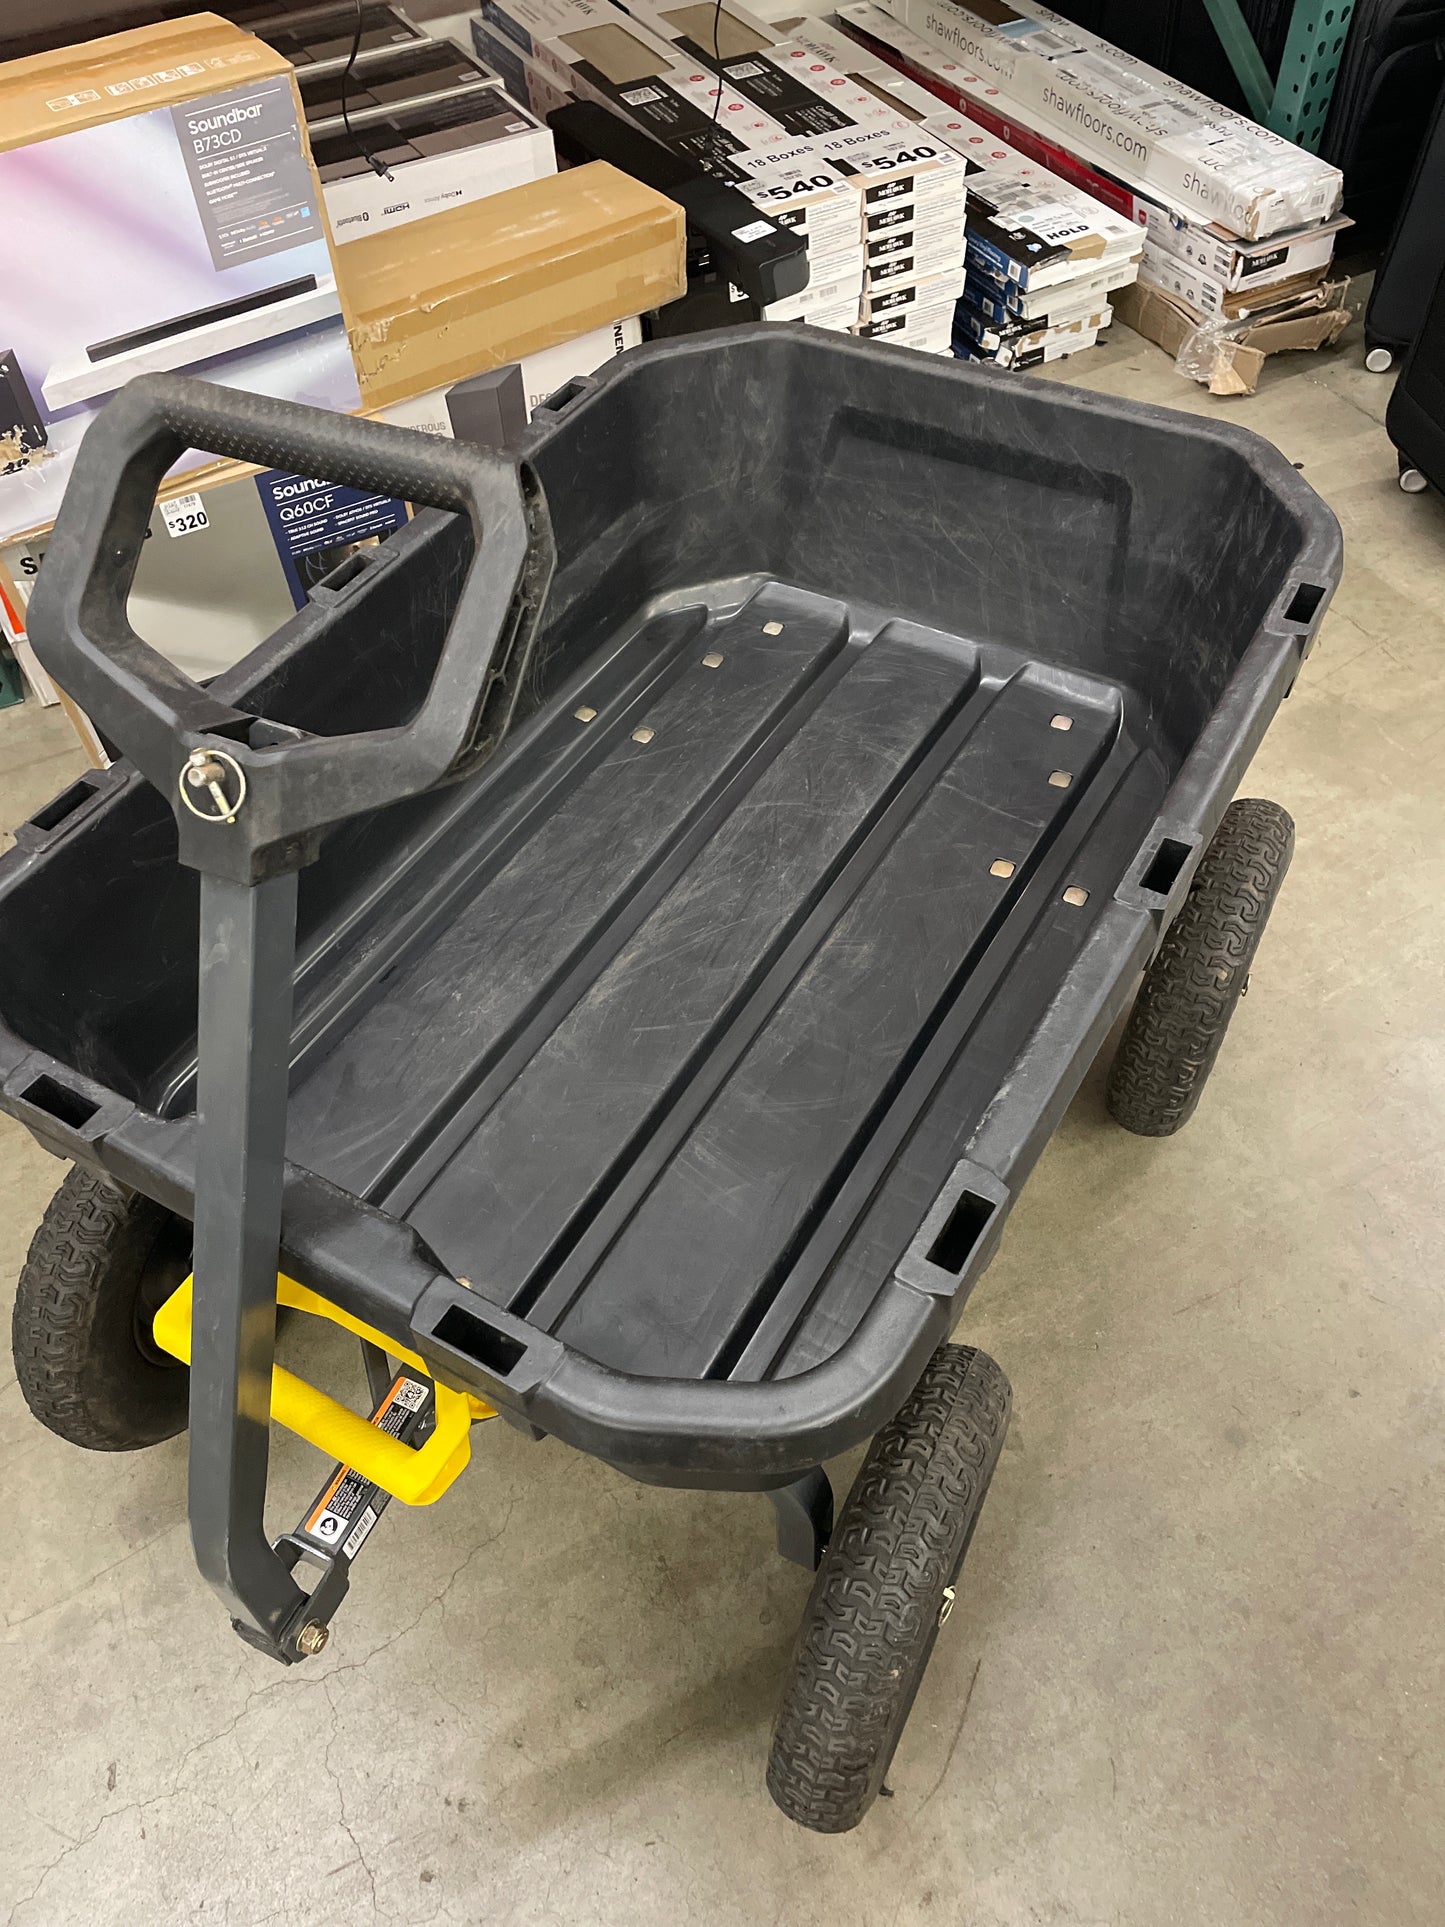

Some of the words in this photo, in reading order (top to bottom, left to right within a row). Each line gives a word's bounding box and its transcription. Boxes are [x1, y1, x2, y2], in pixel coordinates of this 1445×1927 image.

[188, 103, 263, 135] Soundbar
[1043, 86, 1148, 161] shawfloors.com
[1163, 79, 1284, 146] shawfloors.com
[193, 128, 242, 154] B73CD
[824, 140, 842, 151] 18
[844, 129, 890, 146] Boxes
[747, 156, 766, 169] 18
[768, 144, 815, 163] Boxes
[862, 146, 937, 170] $540
[756, 175, 834, 200] $540
[1046, 224, 1090, 240] HOLD
[280, 493, 334, 521] Q60CF
[168, 511, 208, 532] $320
